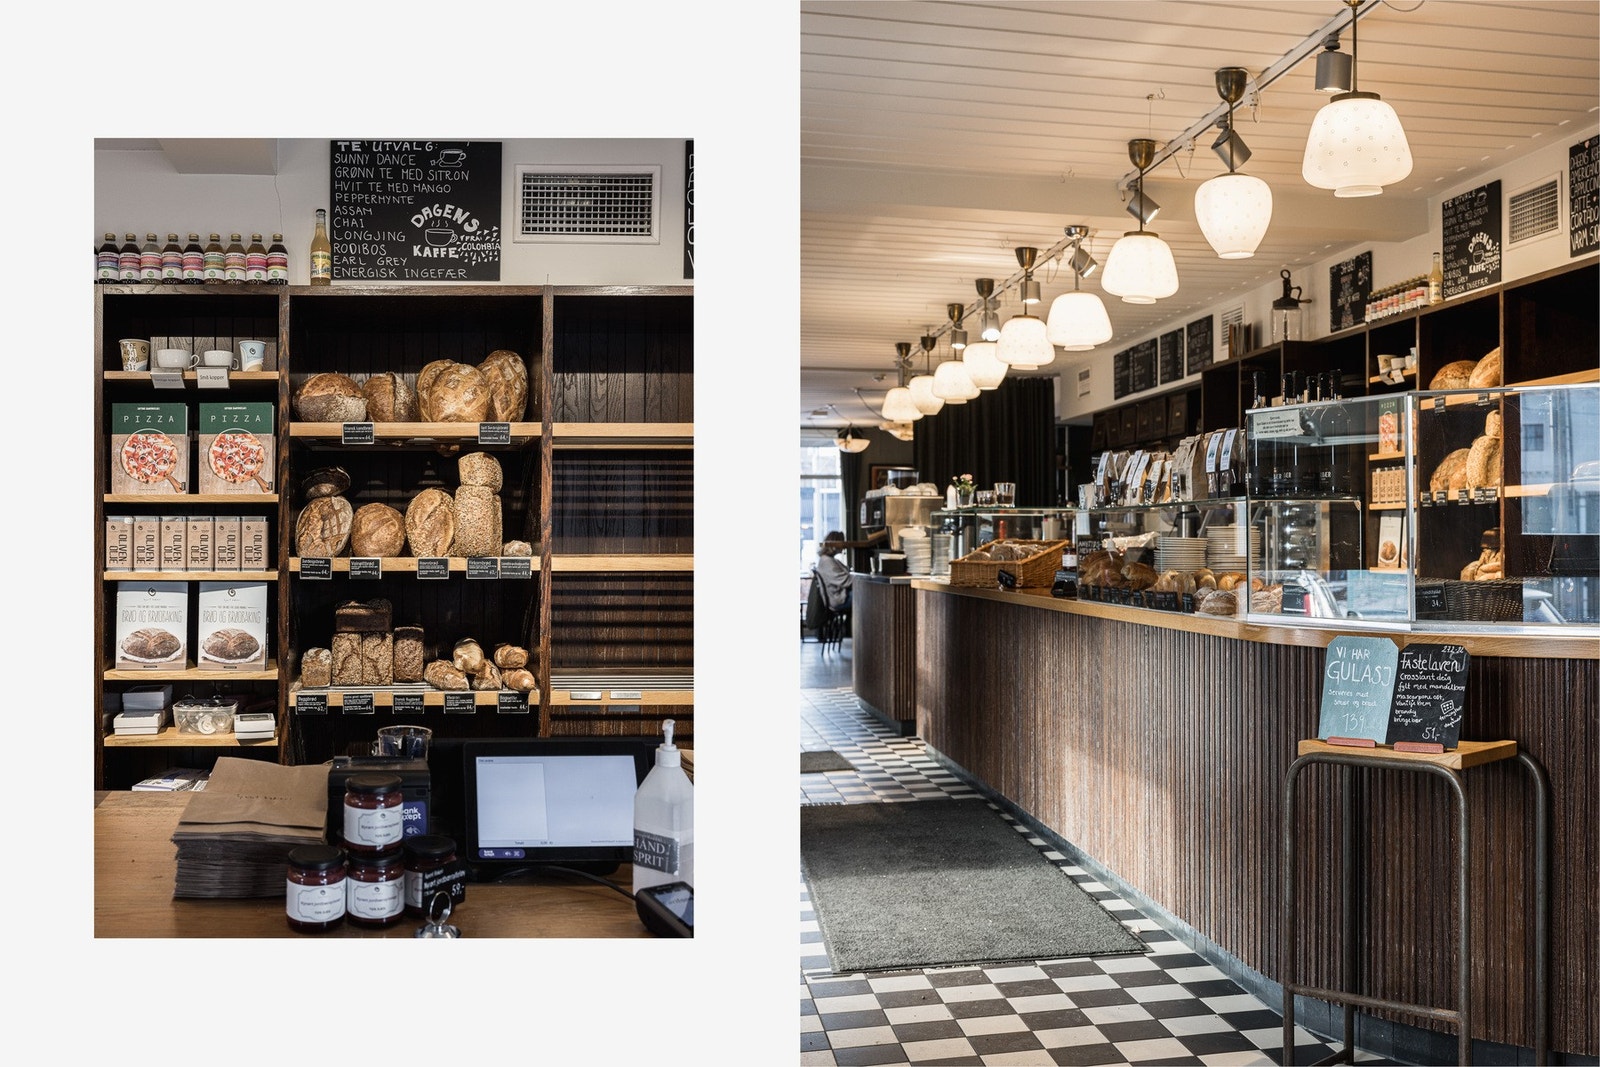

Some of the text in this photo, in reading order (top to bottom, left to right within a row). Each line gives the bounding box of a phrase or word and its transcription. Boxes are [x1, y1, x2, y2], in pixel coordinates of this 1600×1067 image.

[334, 153, 416, 166] SUNNY DANCE
[334, 167, 470, 182] GRØNN TE MED SITRON
[334, 180, 452, 194] HVIT TE MED MANGO
[335, 192, 415, 205] PEPPERMYNTE
[1571, 193, 1591, 215] LATTE
[334, 205, 372, 216] ASSAM
[410, 203, 480, 233] DAGENS
[1571, 205, 1599, 231] CORTADO
[333, 217, 364, 229] CHAI
[333, 230, 406, 242] LONGJING
[1468, 231, 1493, 254] DAGENS
[1571, 228, 1589, 251] VARM
[413, 245, 459, 258] KAFFE
[461, 242, 501, 251] COLOMBIA
[333, 256, 408, 267] EARL GREY
[333, 266, 398, 279] ENERGISK
[404, 268, 468, 279] INGEFÆR
[123, 415, 174, 423] PIZZA
[210, 414, 261, 422] PIZZA
[108, 545, 118, 564] OLJE
[118, 534, 127, 562] OLIVEN
[136, 545, 146, 564] OLJE
[145, 534, 154, 562] OLIVEN
[164, 545, 172, 564] OLJE
[172, 534, 182, 562] OLIVEN
[190, 545, 199, 564] OLJE
[199, 534, 208, 562] OLIVEN
[217, 545, 226, 564] OLJE
[226, 534, 236, 562] OLIVEN
[244, 545, 253, 564] OLJE
[253, 534, 262, 562] OLIVEN
[1336, 646, 1370, 660] VI HAR
[1326, 660, 1391, 687] GULASJ
[1398, 681, 1411, 692] fylt
[1421, 727, 1441, 741] 51,-
[402, 807, 418, 815] ank
[402, 812, 422, 821] xept
[634, 850, 665, 868] SPRIT
